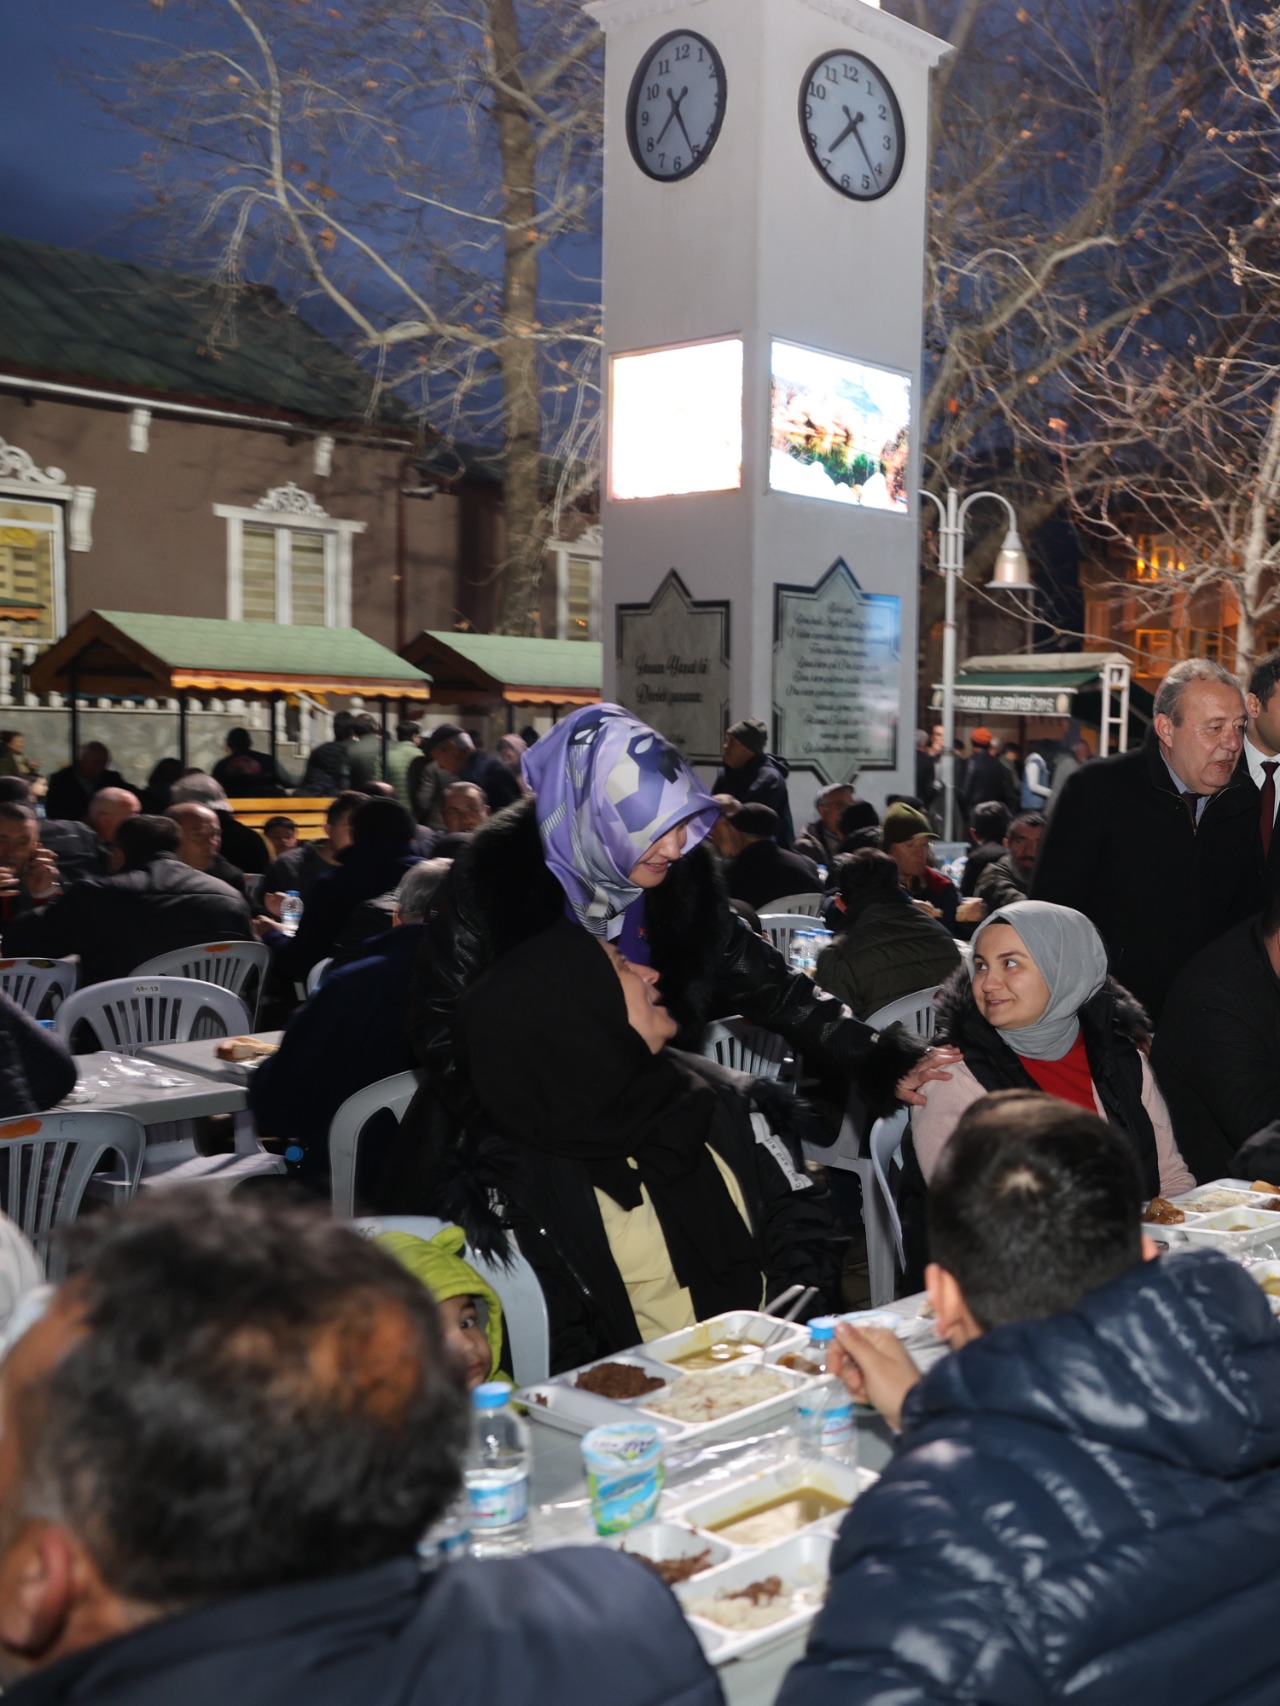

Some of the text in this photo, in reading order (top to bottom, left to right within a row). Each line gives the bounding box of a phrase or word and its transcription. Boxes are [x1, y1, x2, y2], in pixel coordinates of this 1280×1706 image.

[674, 44, 690, 61] 12
[697, 47, 704, 62] 1
[658, 59, 670, 76] 11
[824, 64, 838, 84] 11
[842, 63, 858, 83] 12
[646, 83, 659, 100] 10
[808, 81, 826, 100] 10
[866, 80, 874, 97] 1
[641, 111, 649, 127] 9
[878, 104, 886, 121] 2
[646, 137, 655, 153] 8
[882, 135, 891, 151] 3
[658, 152, 666, 168] 7
[673, 156, 682, 172] 6
[873, 162, 883, 176] 4
[841, 174, 850, 189] 6
[861, 174, 870, 190] 5
